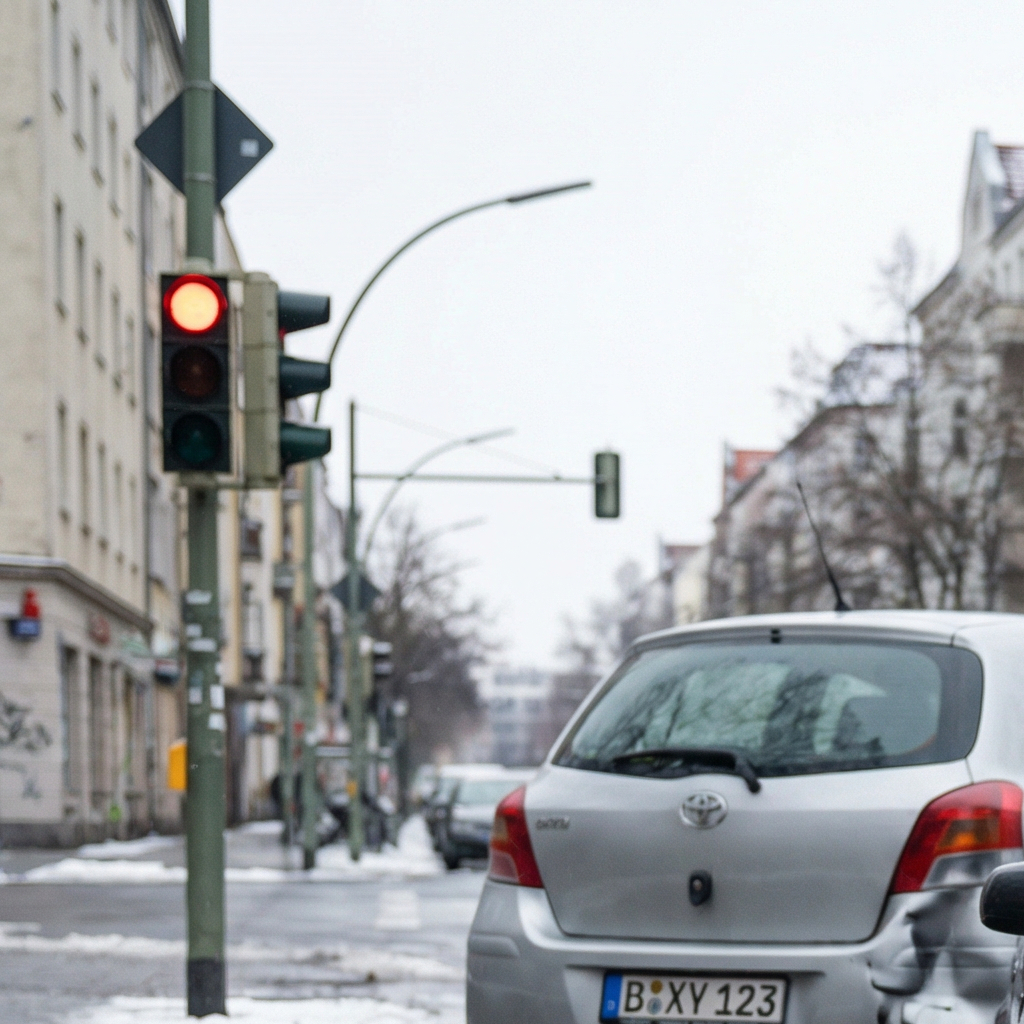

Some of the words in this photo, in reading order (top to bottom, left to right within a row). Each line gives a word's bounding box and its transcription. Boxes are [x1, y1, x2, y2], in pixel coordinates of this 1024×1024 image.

[624, 981, 644, 1012] B
[665, 981, 708, 1014] XY
[715, 983, 777, 1017] 123
